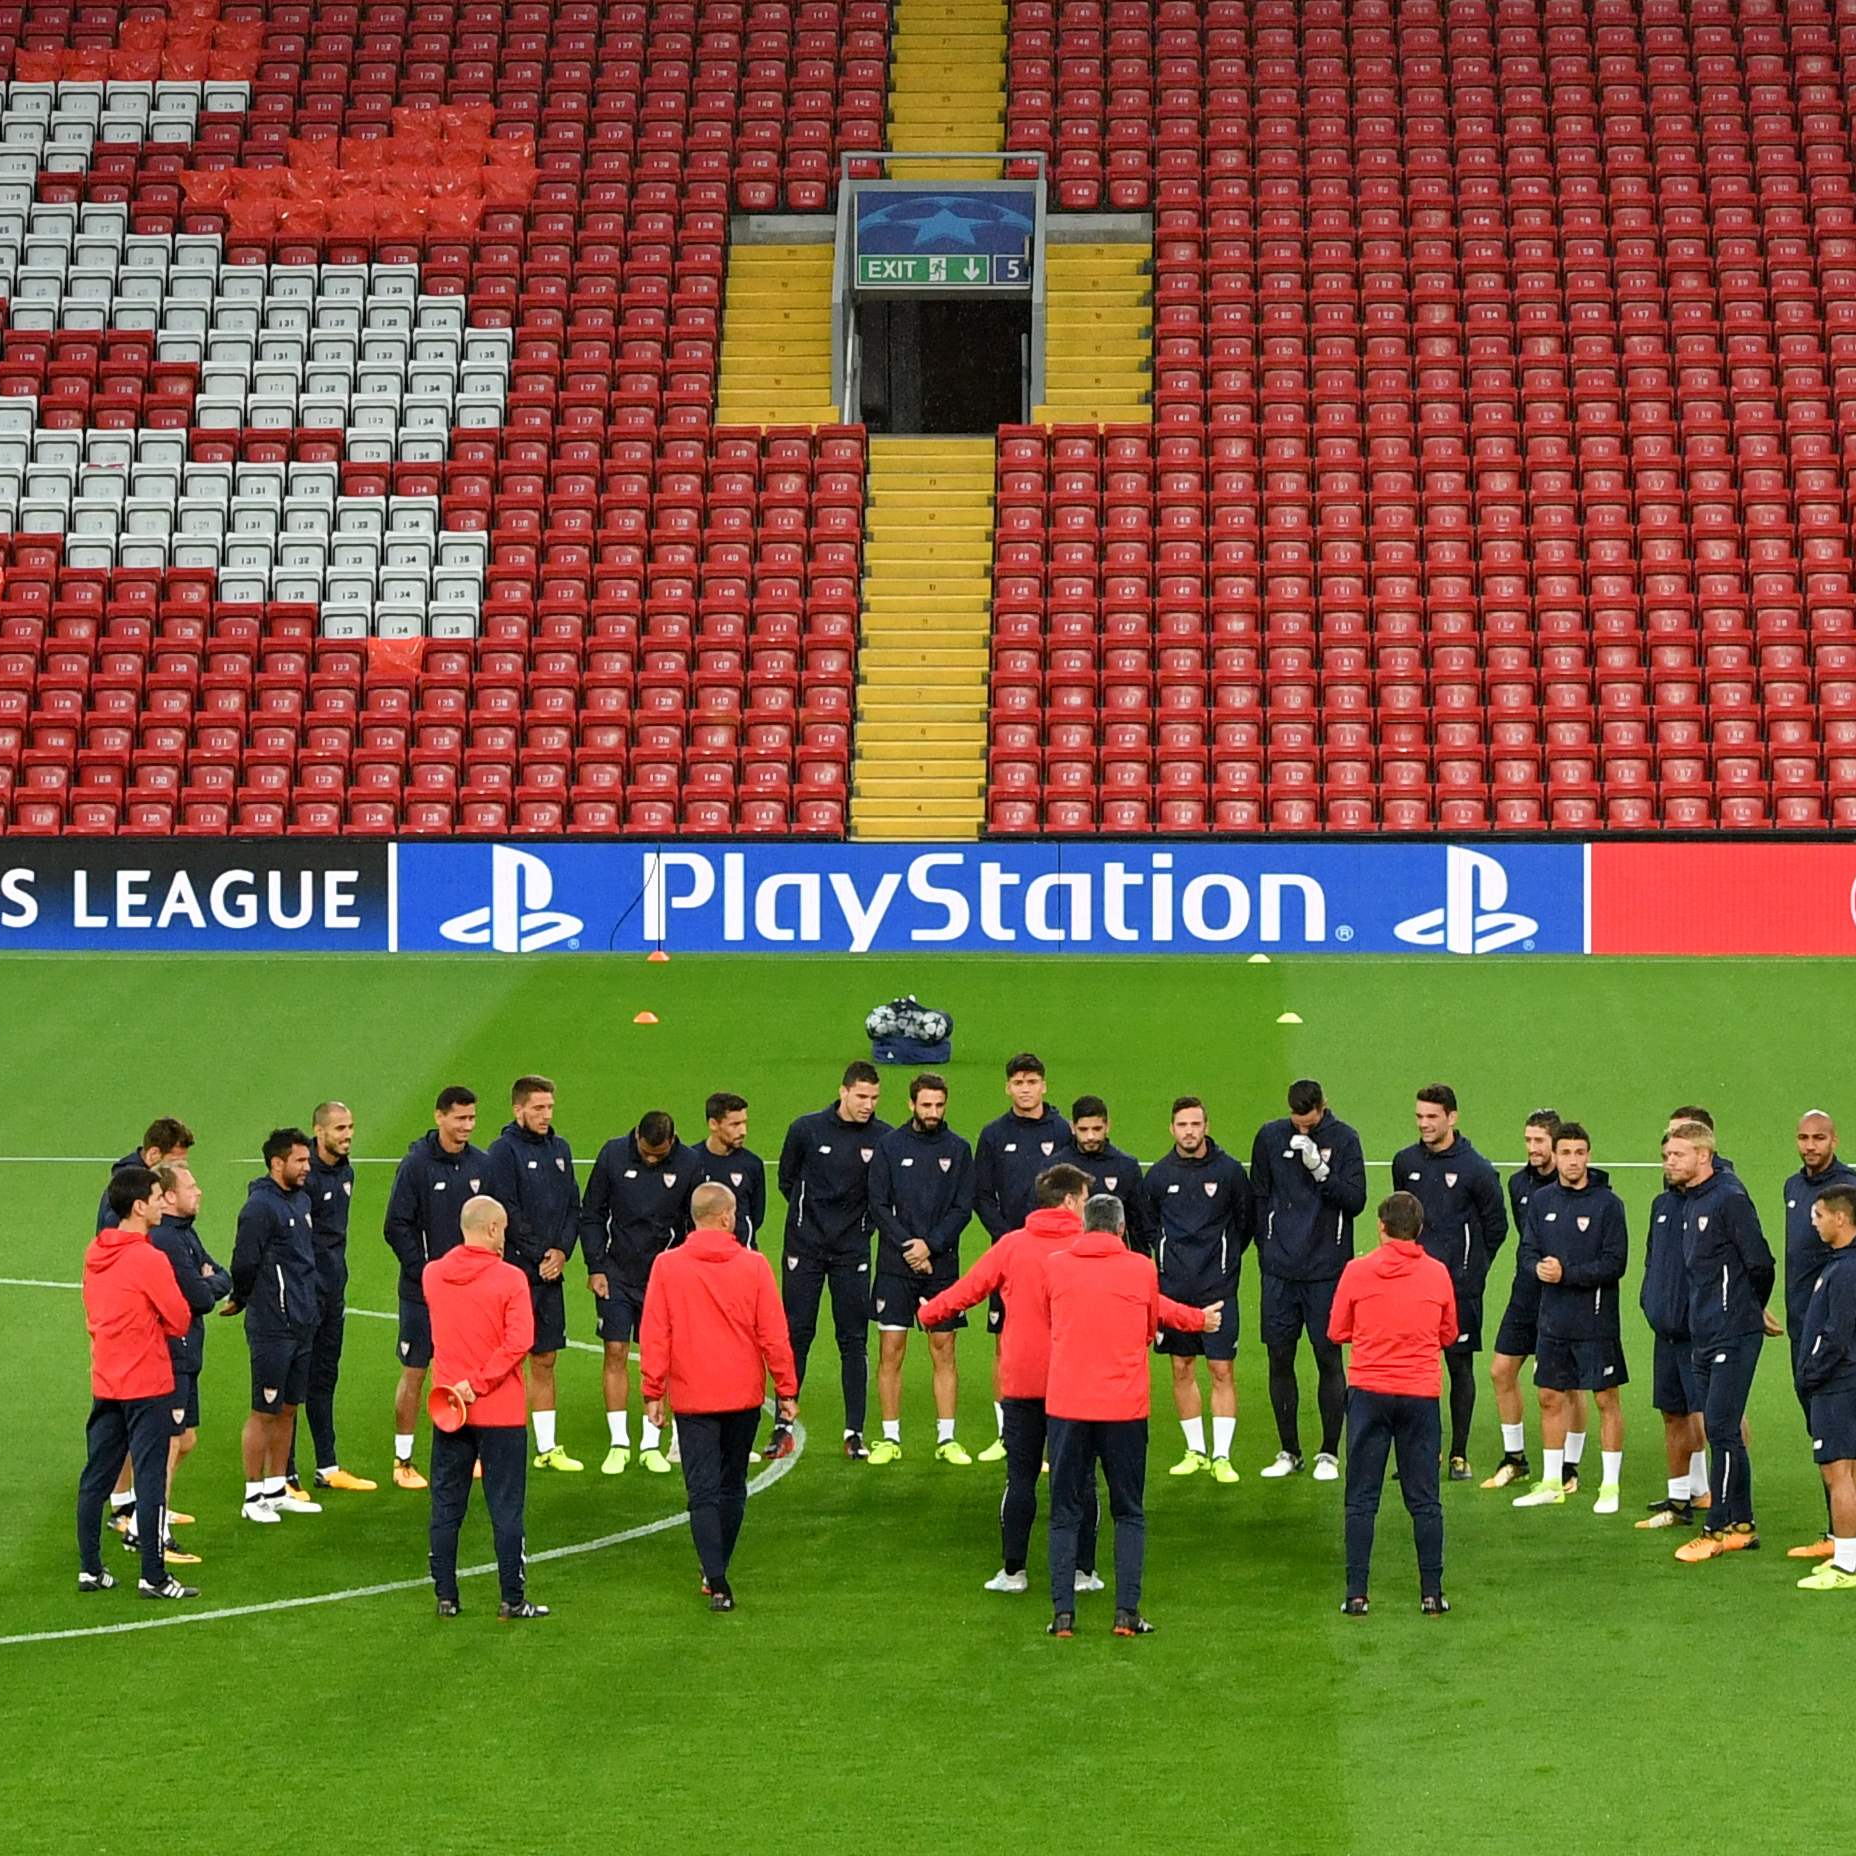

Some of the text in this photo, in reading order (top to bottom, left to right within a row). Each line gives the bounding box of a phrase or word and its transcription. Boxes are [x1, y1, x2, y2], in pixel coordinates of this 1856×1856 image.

[868, 260, 917, 278] EXIT
[1007, 260, 1020, 278] 5
[75, 870, 361, 928] LEAGUE
[644, 853, 1325, 952] PlayStation
